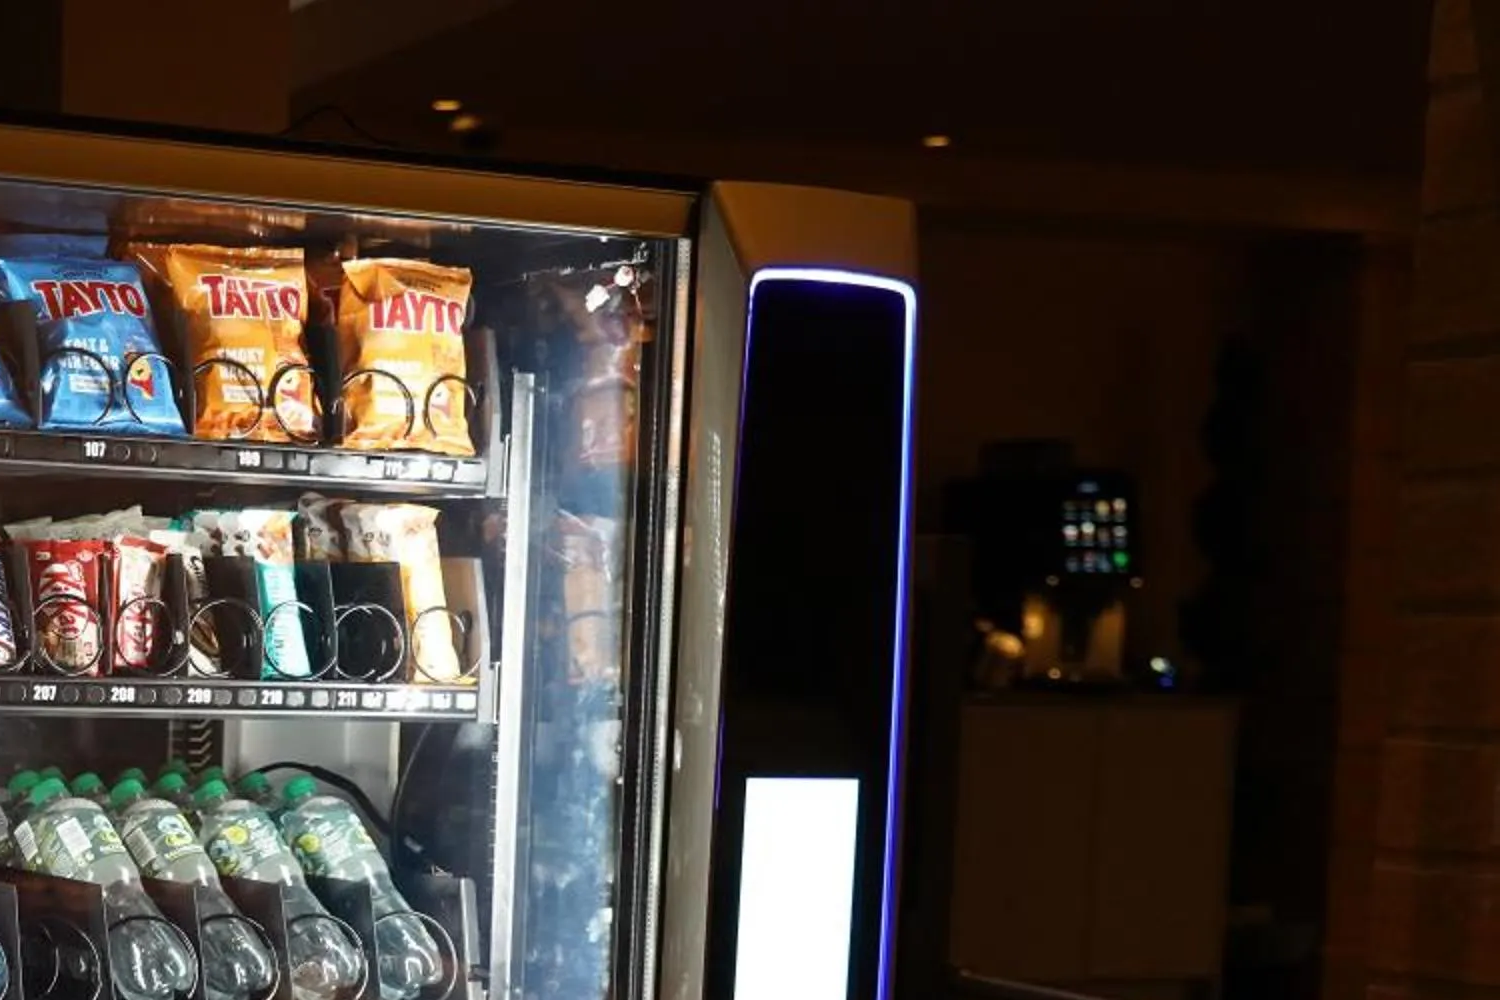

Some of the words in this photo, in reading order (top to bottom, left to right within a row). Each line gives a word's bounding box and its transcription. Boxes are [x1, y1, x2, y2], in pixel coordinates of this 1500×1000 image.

[33, 280, 146, 320] TAYTO
[200, 275, 301, 320] TAYTO
[370, 291, 464, 335] TAYTO
[84, 441, 106, 457] 107
[33, 684, 57, 701] 207
[110, 686, 136, 703] 208
[337, 691, 357, 707] 211
